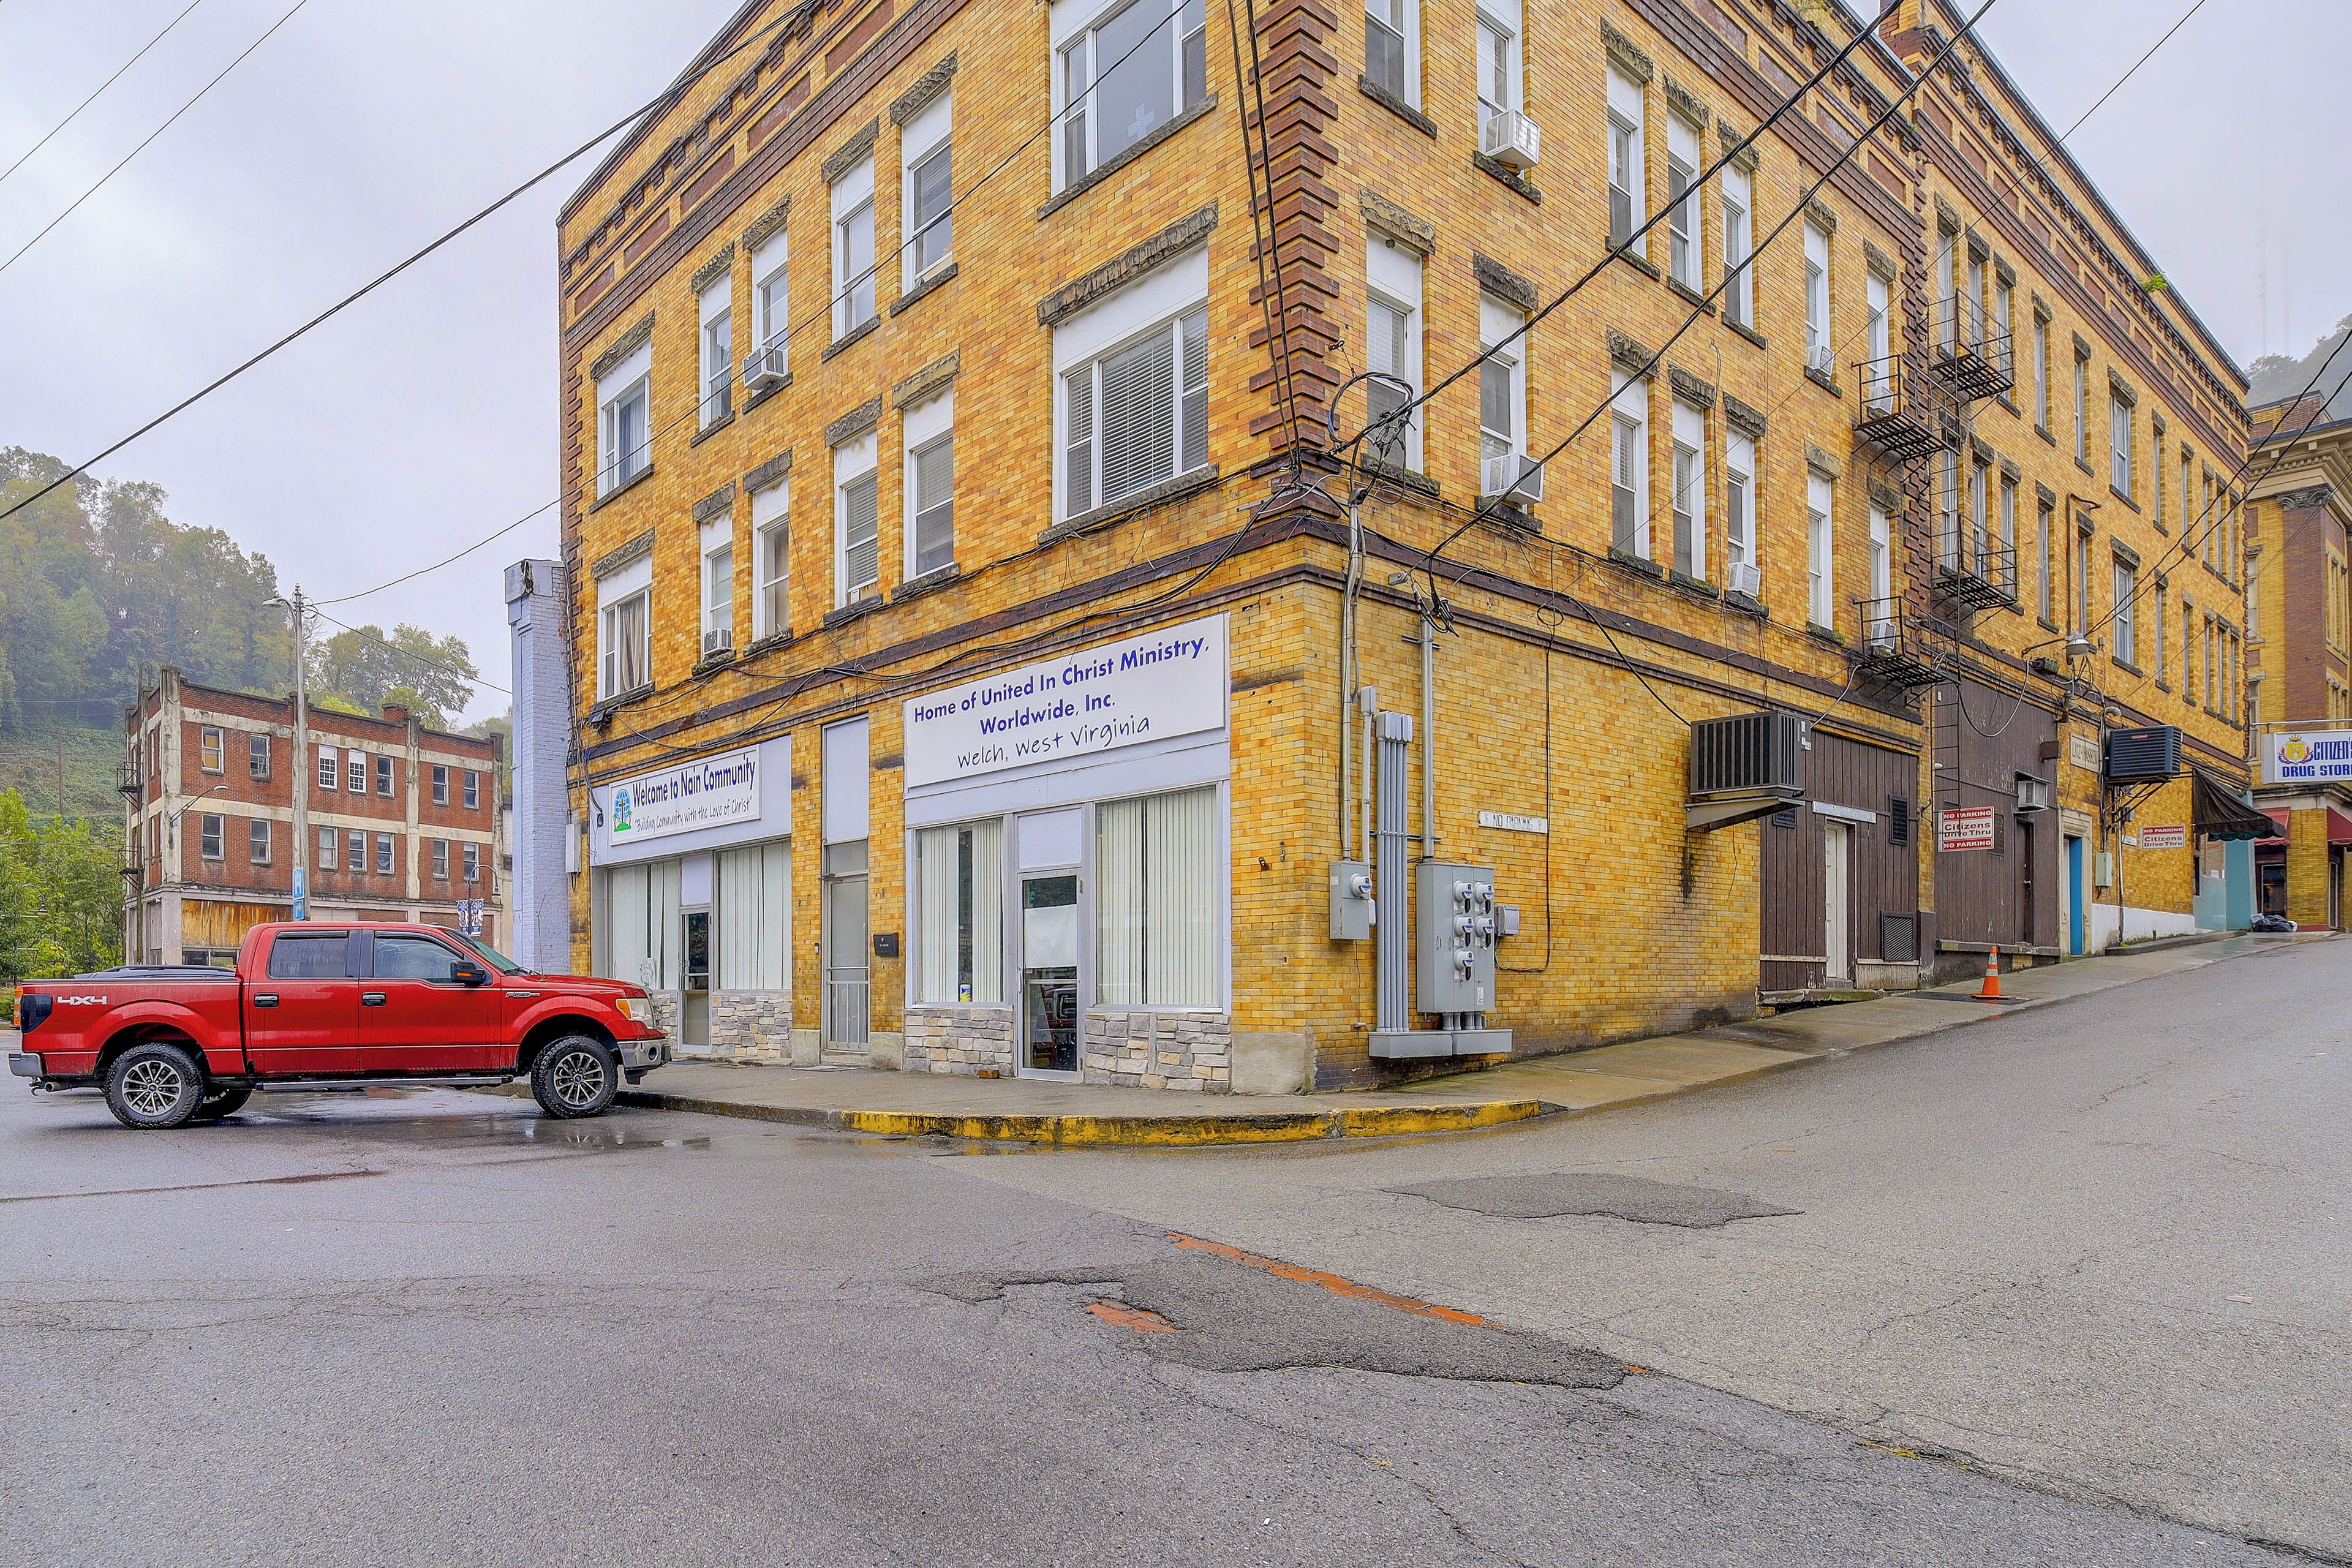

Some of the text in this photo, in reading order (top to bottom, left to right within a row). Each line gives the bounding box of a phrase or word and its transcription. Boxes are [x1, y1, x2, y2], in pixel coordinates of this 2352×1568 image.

[914, 637, 1209, 723] Home of United In Christ Ministry,
[980, 694, 1115, 734] Worldwide, Inc.
[958, 714, 1150, 769] Welch, West Virginia
[2314, 736, 2352, 760] CITIZEN'
[633, 754, 756, 808] Welcome to Nain Community
[2282, 764, 2352, 777] DRUG STOR
[657, 810, 683, 828] Community
[684, 807, 696, 823] with
[698, 805, 707, 820] the
[709, 804, 723, 818] Love
[724, 799, 730, 816] of
[1493, 814, 1532, 830] NO PARKING
